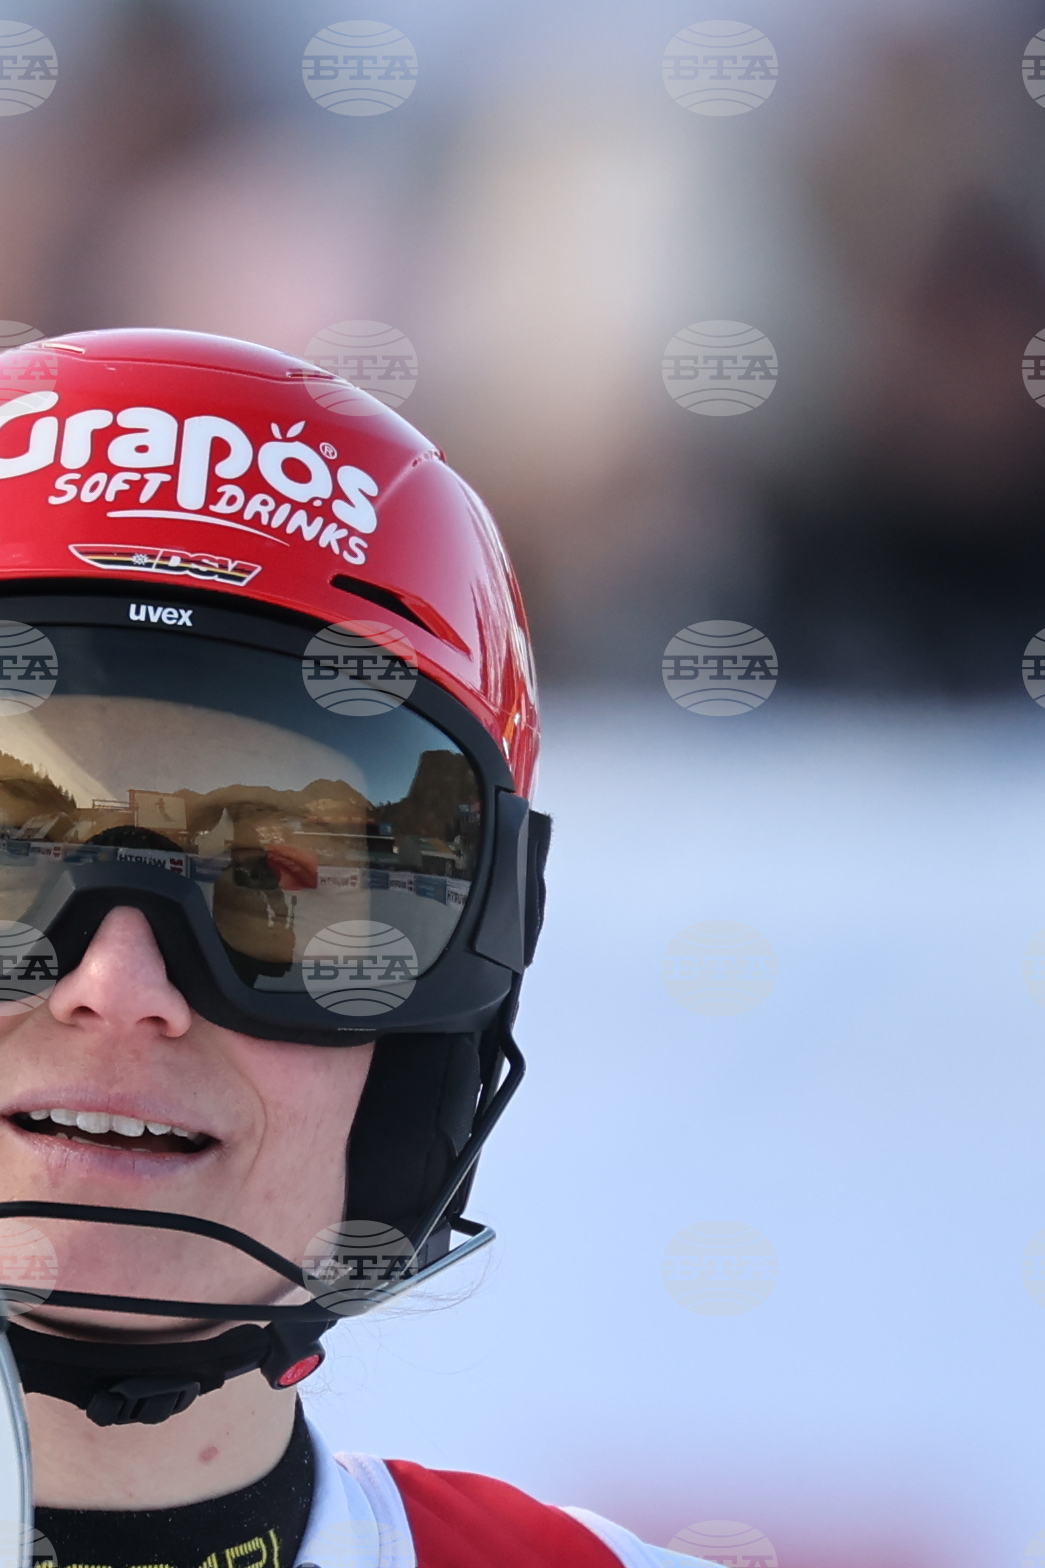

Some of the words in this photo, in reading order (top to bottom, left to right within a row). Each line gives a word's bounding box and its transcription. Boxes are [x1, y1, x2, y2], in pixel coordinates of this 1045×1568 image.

[48, 472, 171, 505] SOFT
[209, 484, 369, 566] DRINKS
[129, 603, 194, 626] uvex
